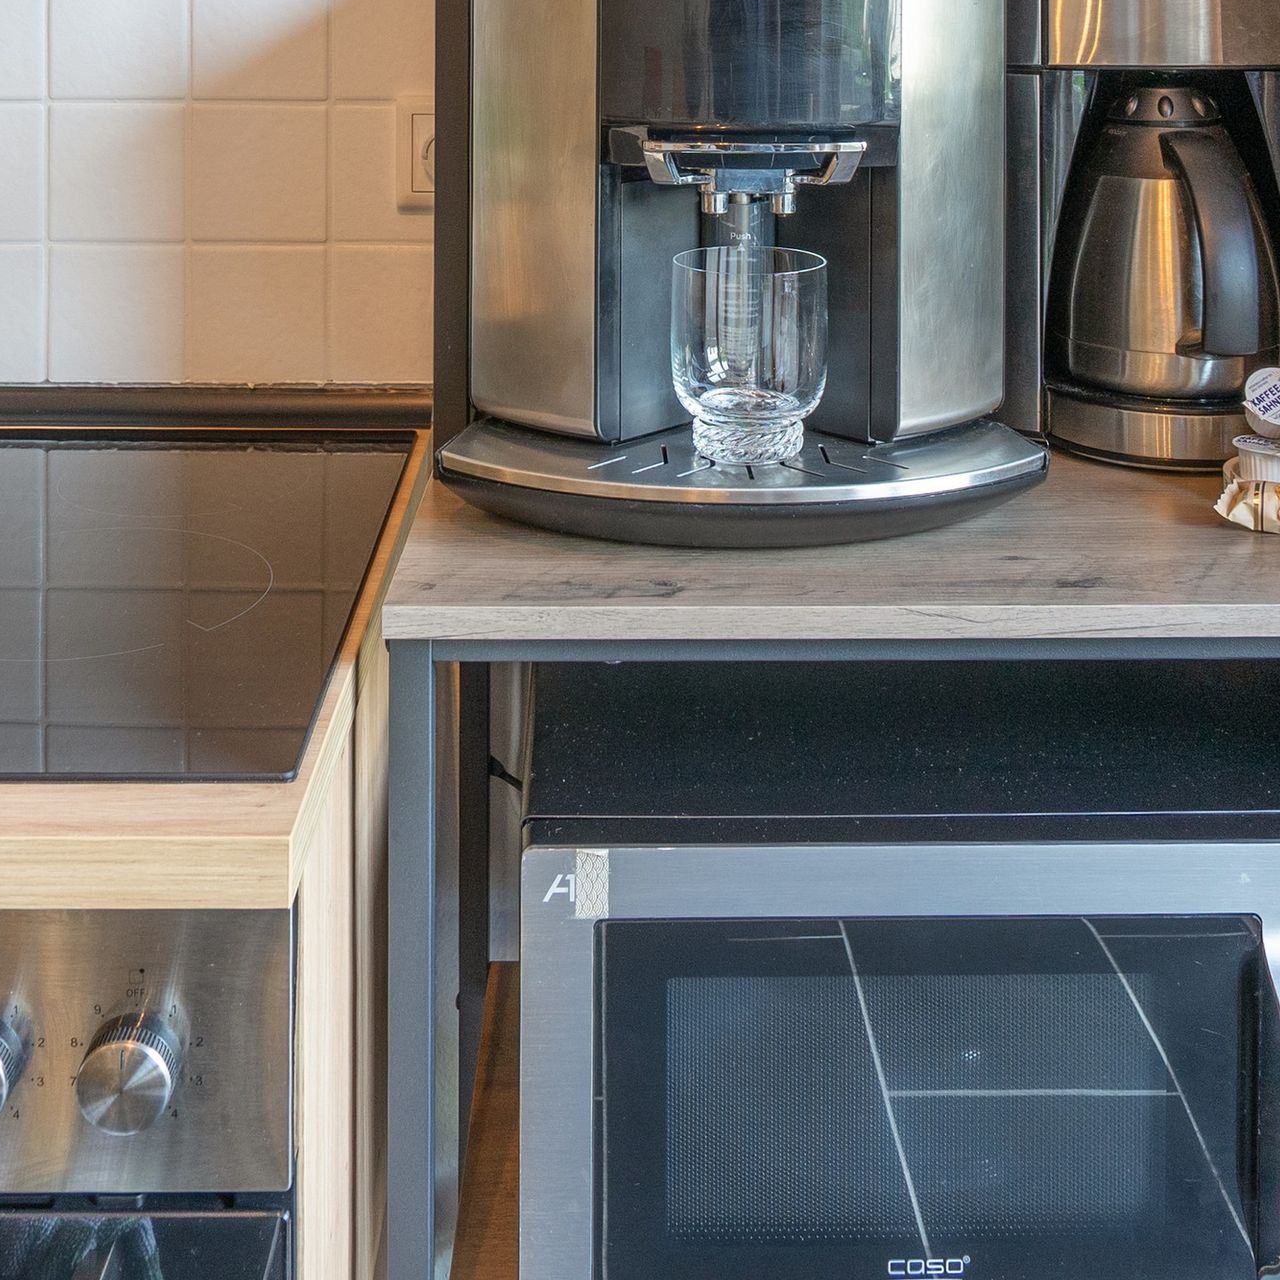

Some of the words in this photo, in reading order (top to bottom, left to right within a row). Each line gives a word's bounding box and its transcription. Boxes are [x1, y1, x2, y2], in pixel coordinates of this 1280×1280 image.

[730, 232, 752, 240] Push
[126, 988, 145, 998] OFF
[94, 1004, 102, 1015] 9
[38, 1038, 46, 1048] 2
[70, 1038, 78, 1047] 8
[196, 1037, 204, 1047] 2
[37, 1077, 45, 1087] 3
[195, 1076, 203, 1086] 3
[13, 1110, 20, 1120] 4
[171, 1109, 178, 1119] 4
